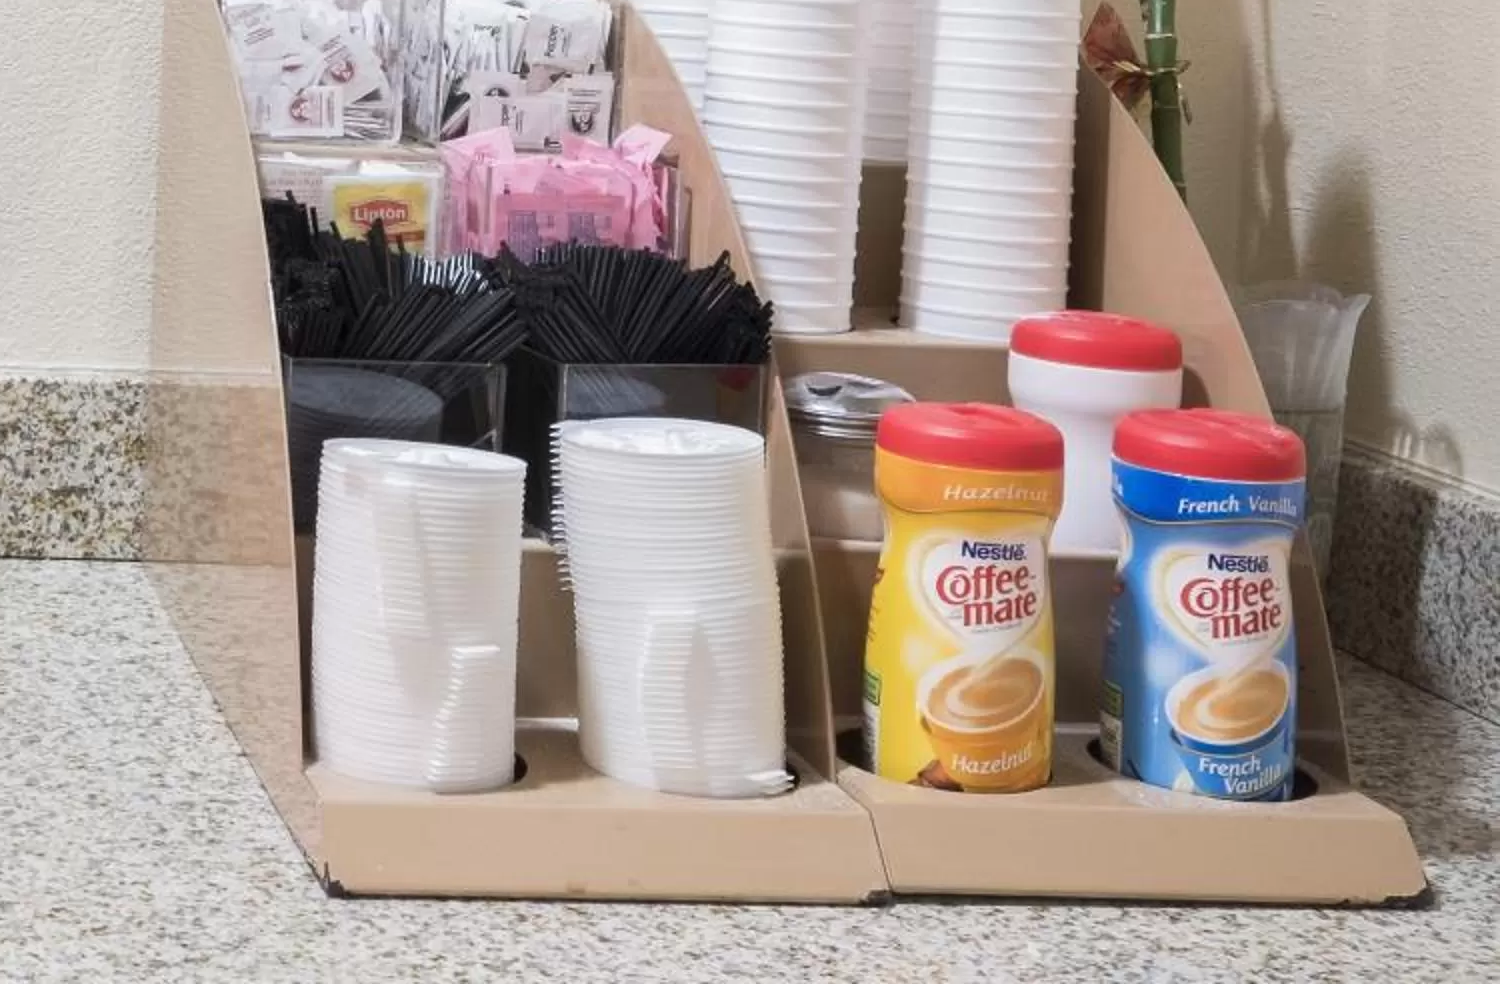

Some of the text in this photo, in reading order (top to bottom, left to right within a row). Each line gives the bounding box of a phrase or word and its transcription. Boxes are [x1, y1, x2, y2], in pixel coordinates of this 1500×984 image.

[354, 206, 406, 226] Lipton
[943, 483, 1050, 502] Hazelnut
[1178, 494, 1297, 517] French Vanilla
[963, 590, 1037, 627] mate
[1211, 603, 1281, 639] mate
[950, 739, 1033, 776] Hazelnut
[1198, 752, 1262, 778] French
[1222, 763, 1282, 795] Vanilla
